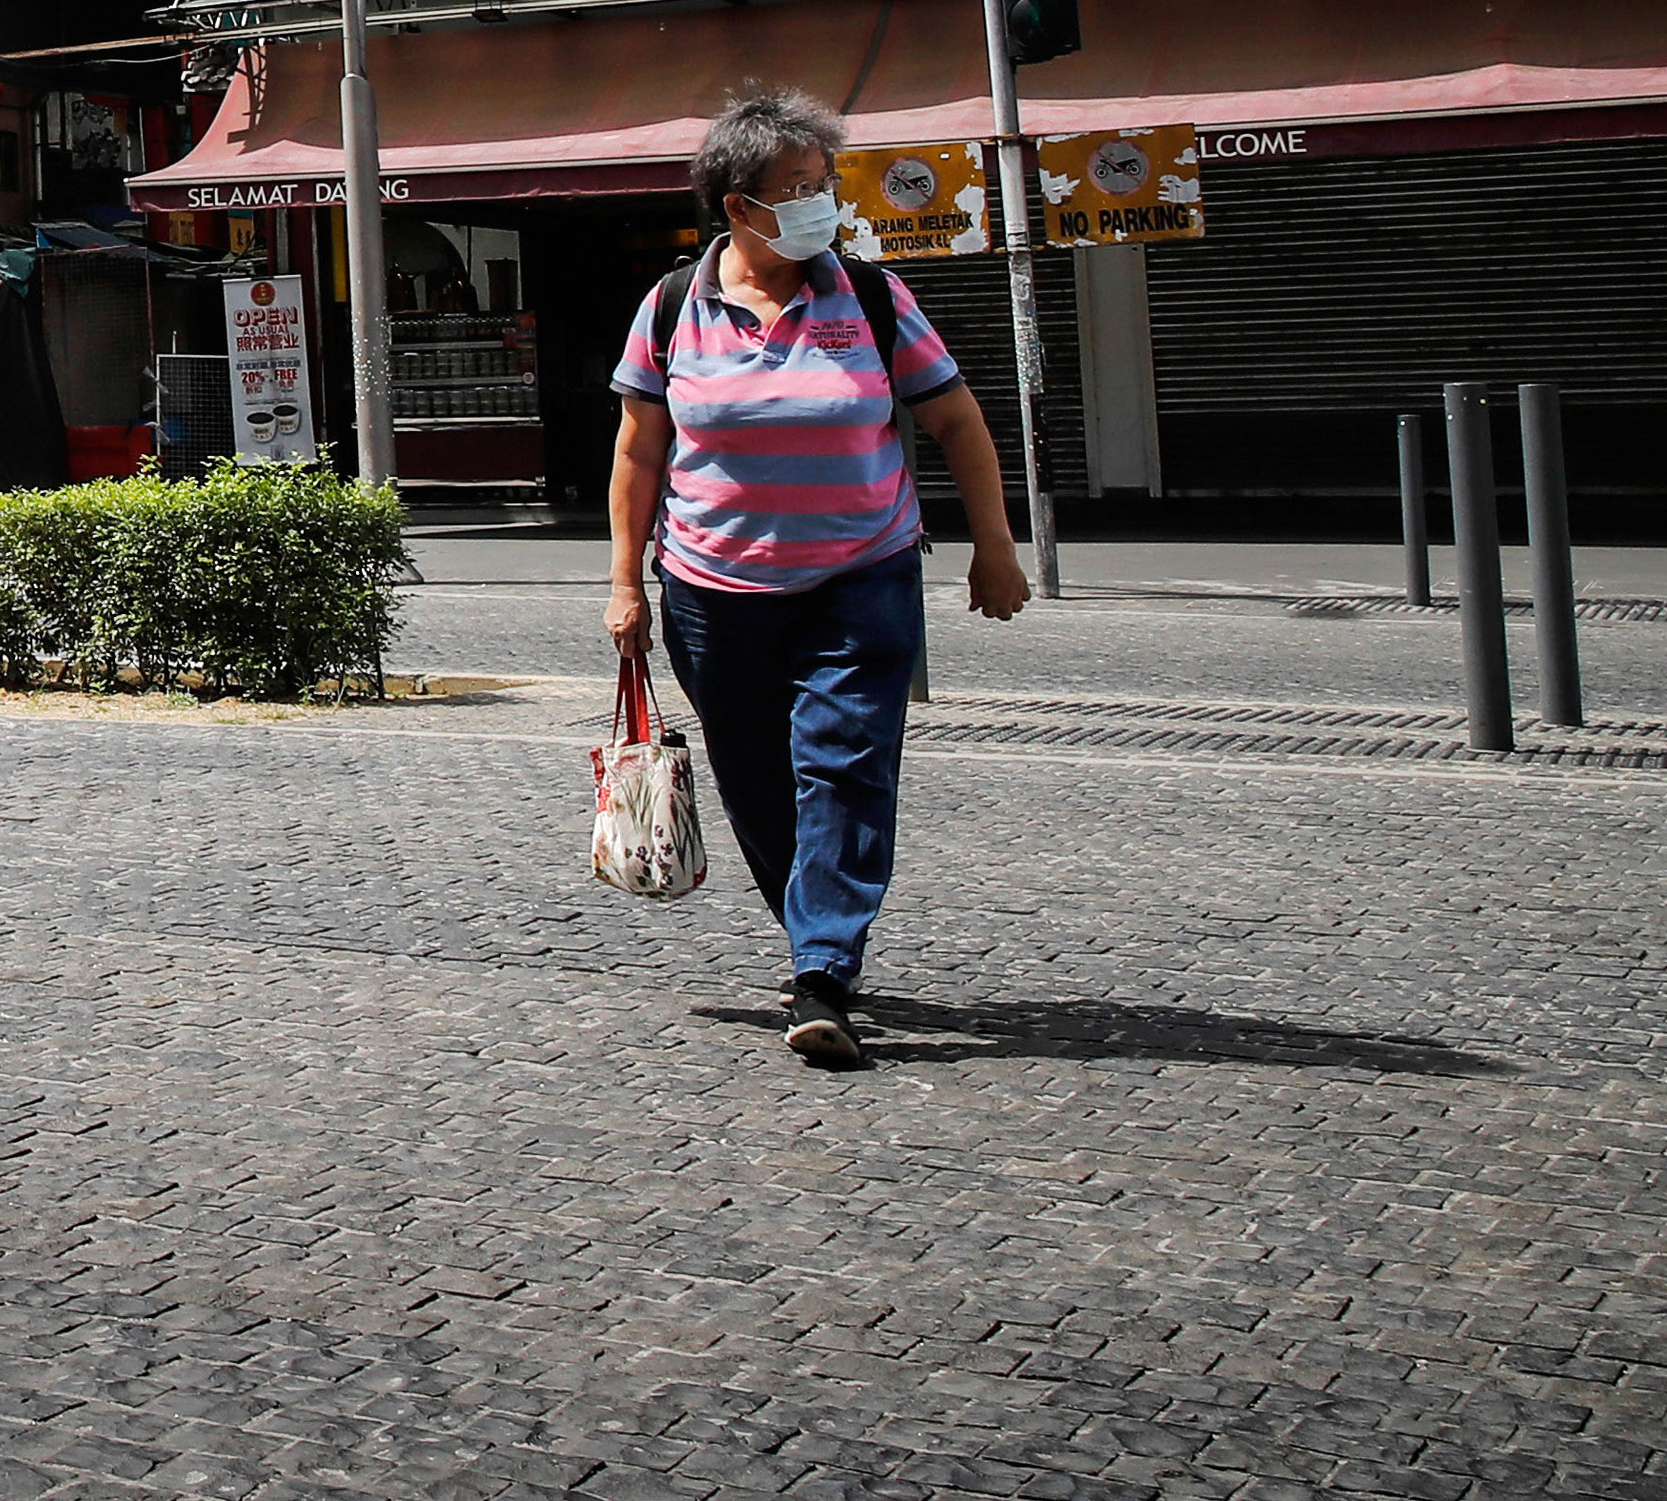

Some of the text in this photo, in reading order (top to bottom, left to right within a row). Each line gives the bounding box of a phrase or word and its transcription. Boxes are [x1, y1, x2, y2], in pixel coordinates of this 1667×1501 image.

[1197, 131, 1307, 159] LCOME
[187, 179, 409, 208] SELAMAT DANG
[873, 213, 973, 235] ARANG MELETAK
[1060, 205, 1190, 237] NO PARKING
[881, 233, 951, 252] MOTOSIKAL
[233, 306, 300, 328] OPEN
[243, 325, 289, 336] AS USUAL
[241, 371, 265, 385] 20%
[275, 369, 298, 380] FREE
